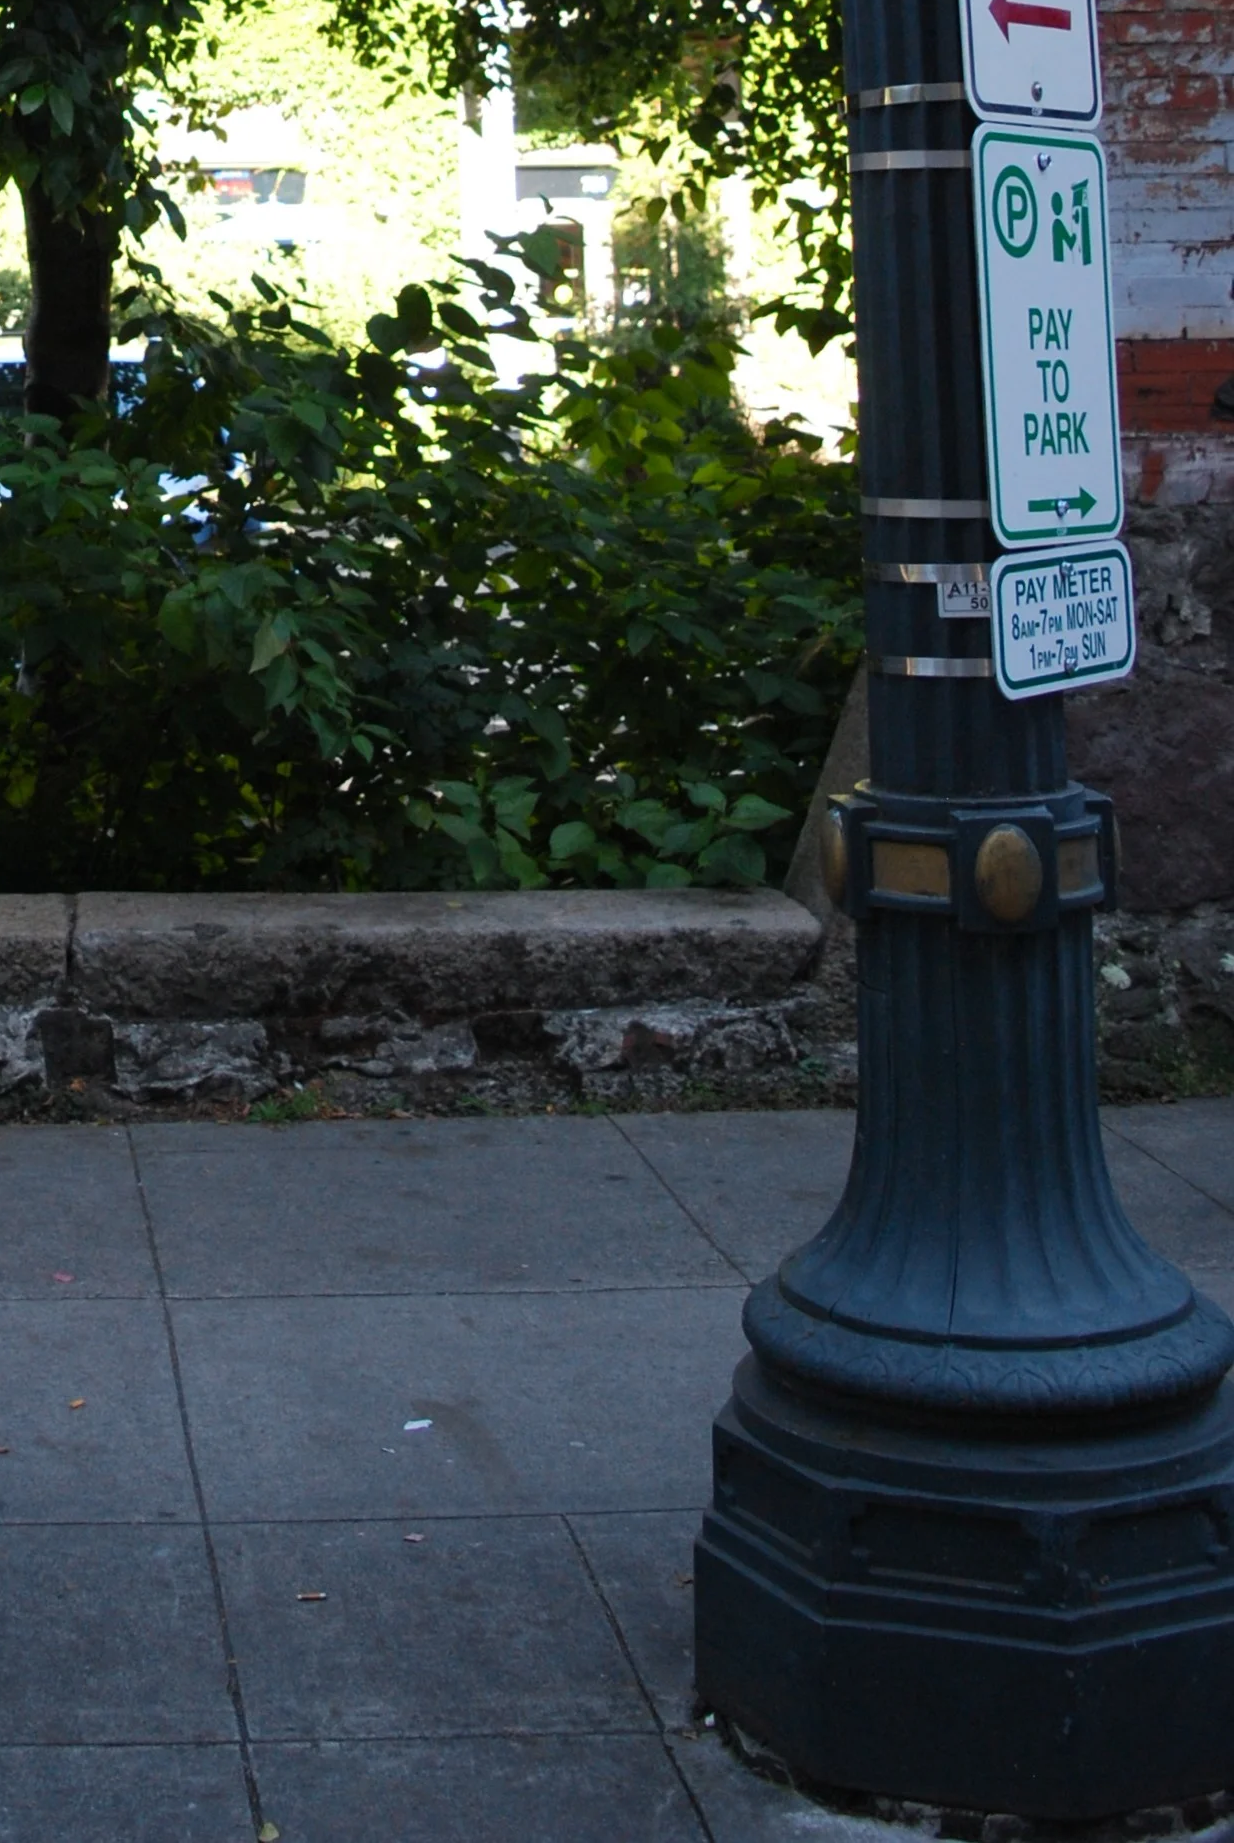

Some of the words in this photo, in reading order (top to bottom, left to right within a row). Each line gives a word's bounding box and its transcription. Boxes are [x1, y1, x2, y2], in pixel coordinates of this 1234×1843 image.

[1006, 185, 1028, 240] P
[1028, 307, 1073, 350] PAY
[1036, 359, 1070, 403] TO
[1023, 412, 1090, 456] PARK
[1014, 576, 1047, 606] PAY
[1053, 566, 1112, 600] METER
[1066, 597, 1118, 630] MON-SAT
[1082, 631, 1106, 660] SUN
